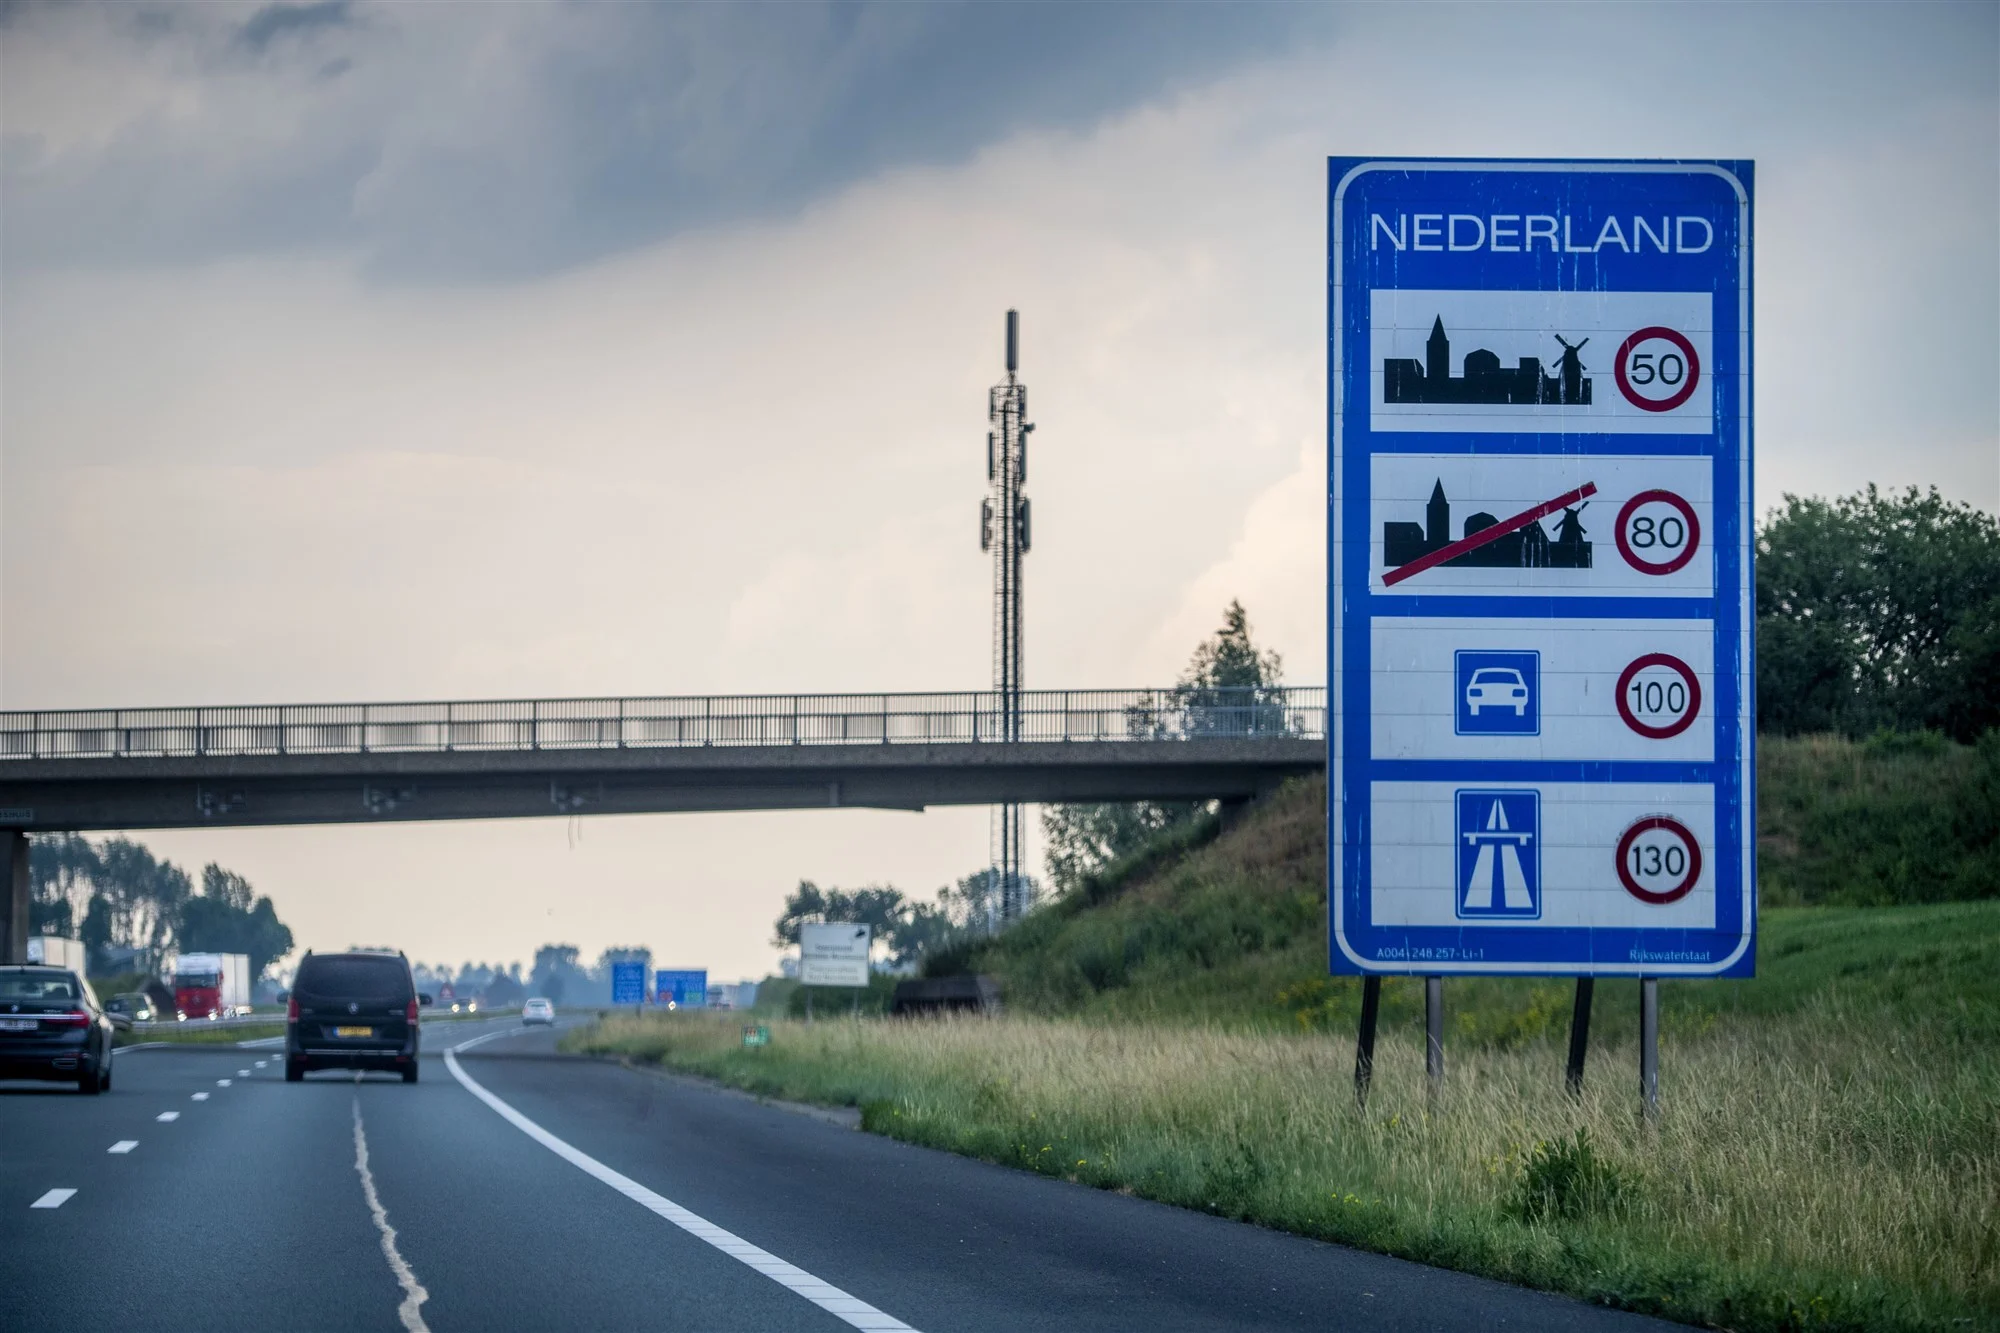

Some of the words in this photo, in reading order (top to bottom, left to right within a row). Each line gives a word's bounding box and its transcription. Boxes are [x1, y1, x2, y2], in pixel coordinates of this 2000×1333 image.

[1371, 213, 1714, 254] NEDERLAND
[1631, 353, 1684, 385] 50
[1631, 517, 1684, 548] 80
[1631, 681, 1685, 713] 100
[1633, 845, 1685, 877] 130
[1629, 949, 1711, 961] Rijkswaterstaat
